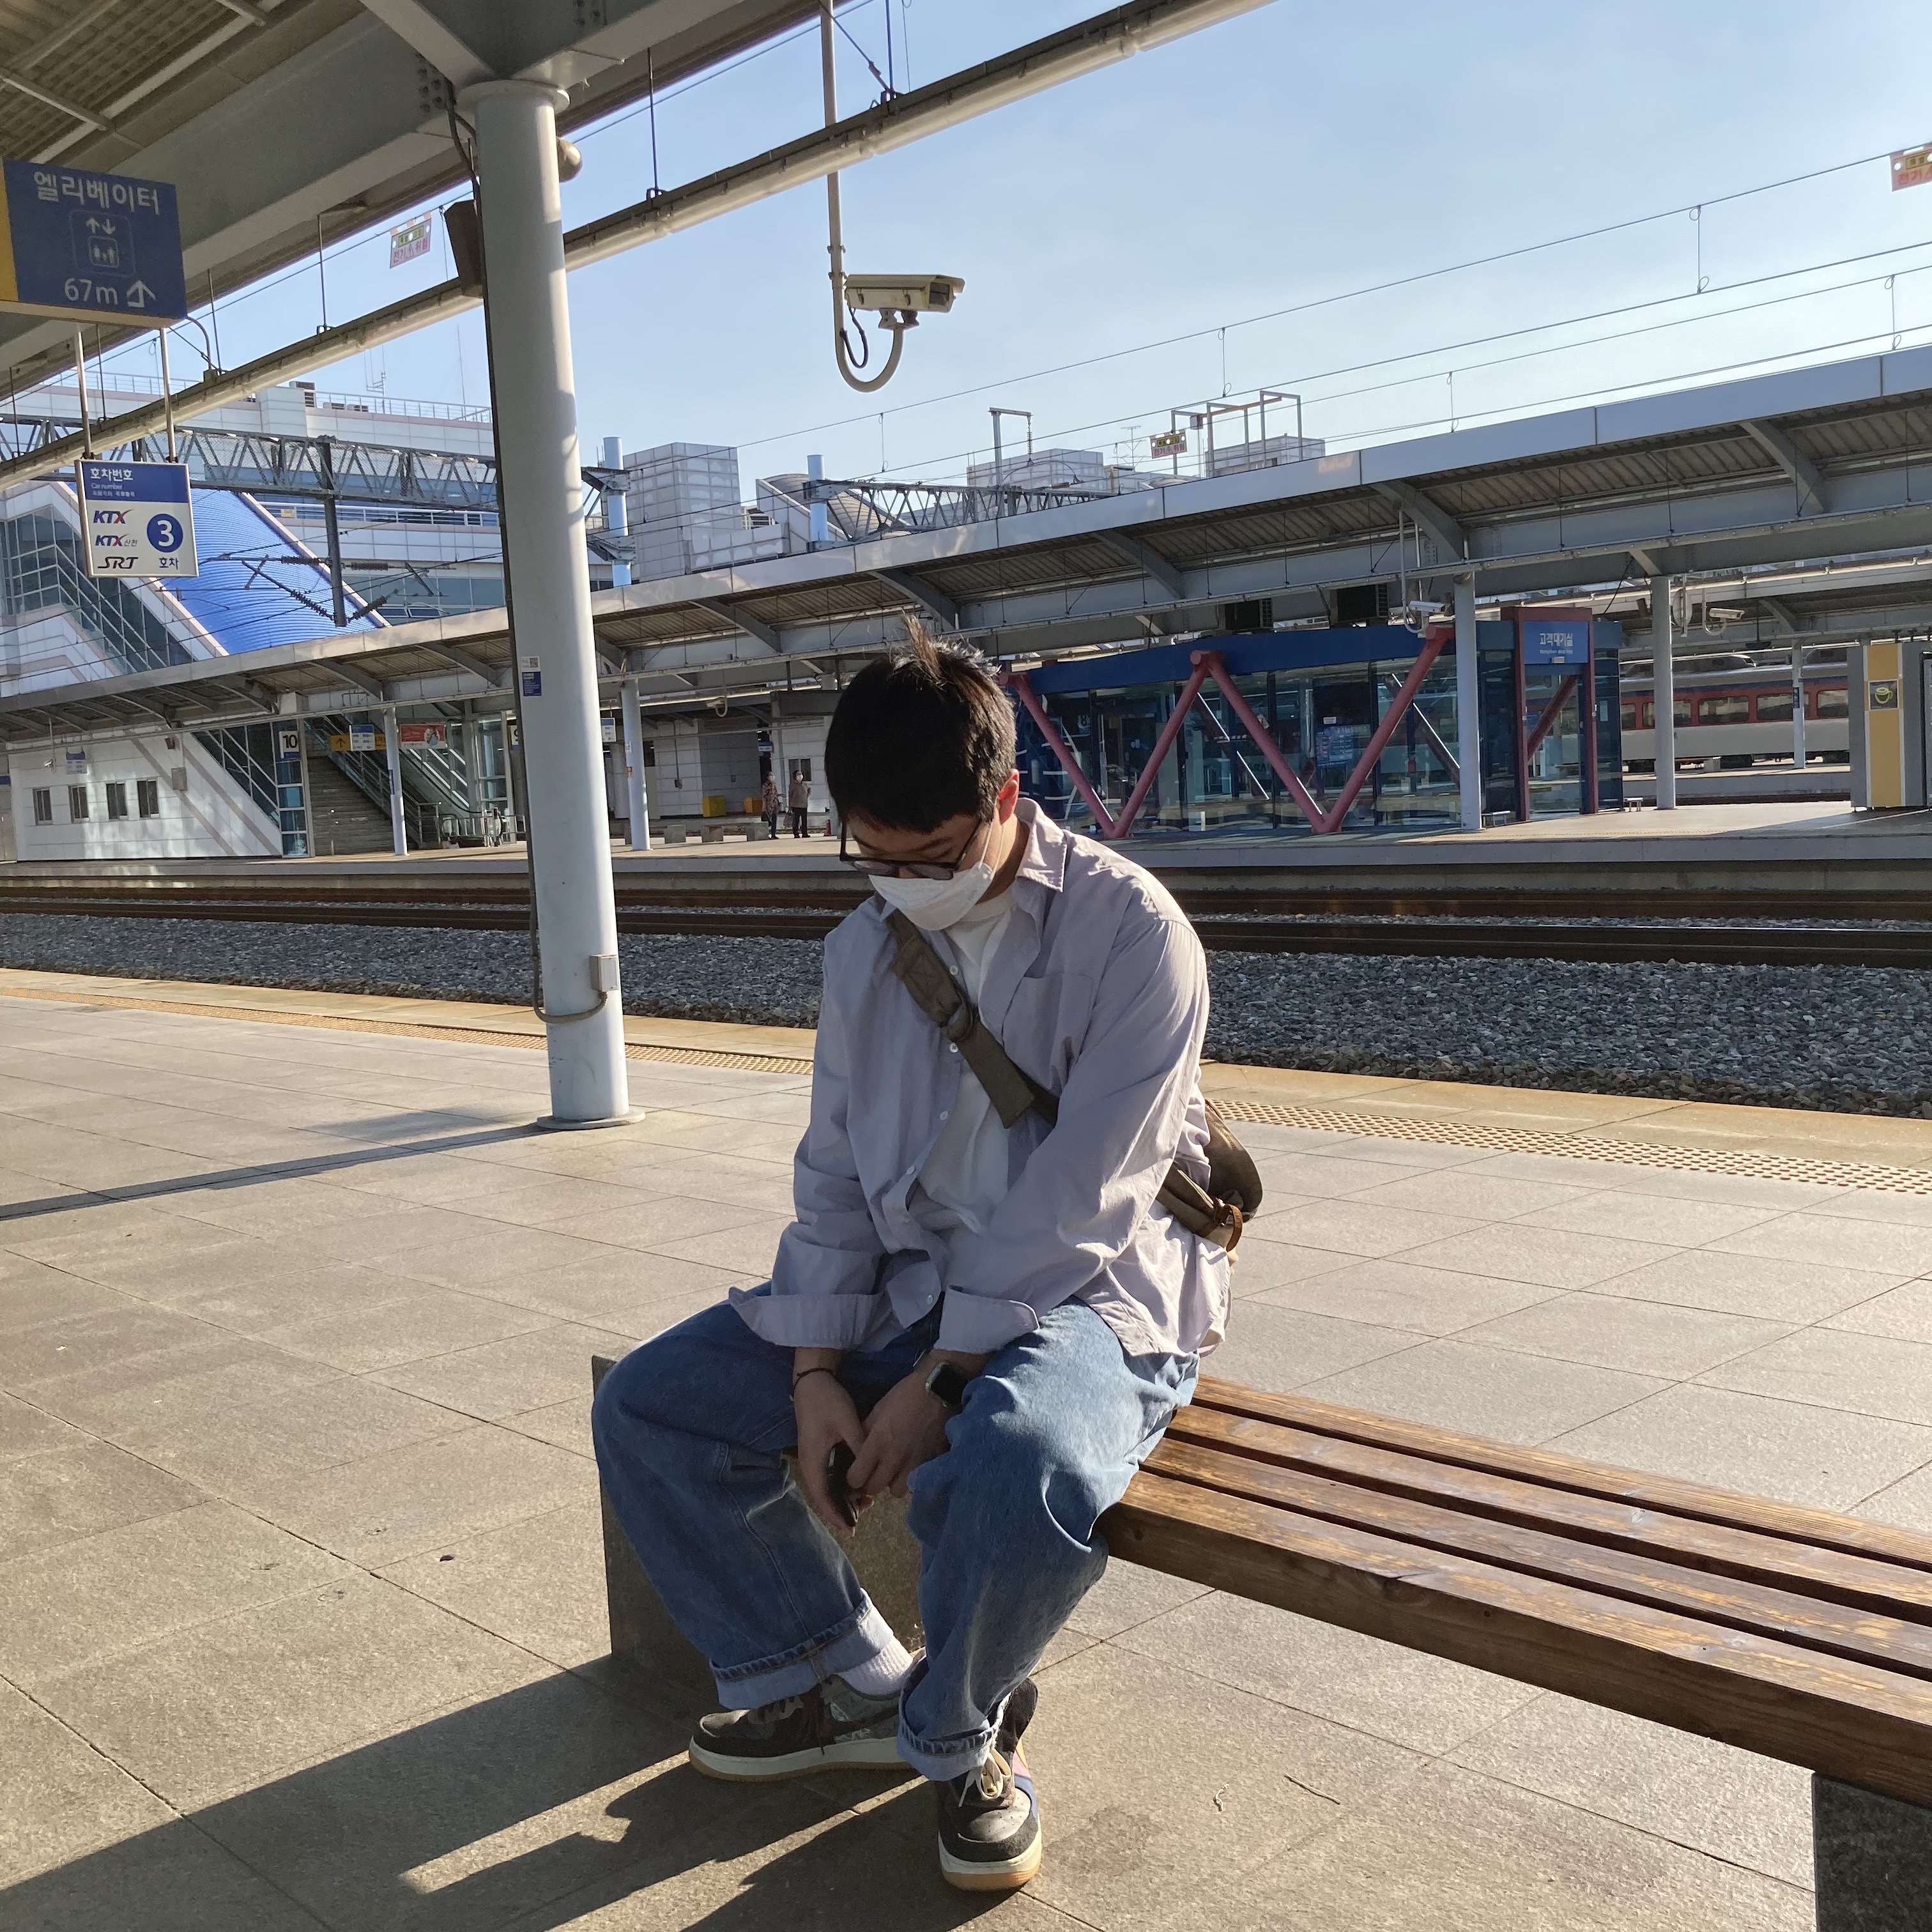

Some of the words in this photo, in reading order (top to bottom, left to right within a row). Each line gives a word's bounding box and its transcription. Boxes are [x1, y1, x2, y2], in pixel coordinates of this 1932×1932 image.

[34, 171, 160, 215] 엘리베이터
[64, 277, 119, 305] 67m
[90, 468, 134, 482] 호차번호
[93, 509, 135, 524] KTX
[95, 533, 129, 547] KTX
[157, 519, 175, 548] 3
[97, 556, 139, 569] SRT
[158, 556, 179, 571] 호차
[1539, 632, 1574, 647] 고객대기실
[282, 734, 298, 748] 10
